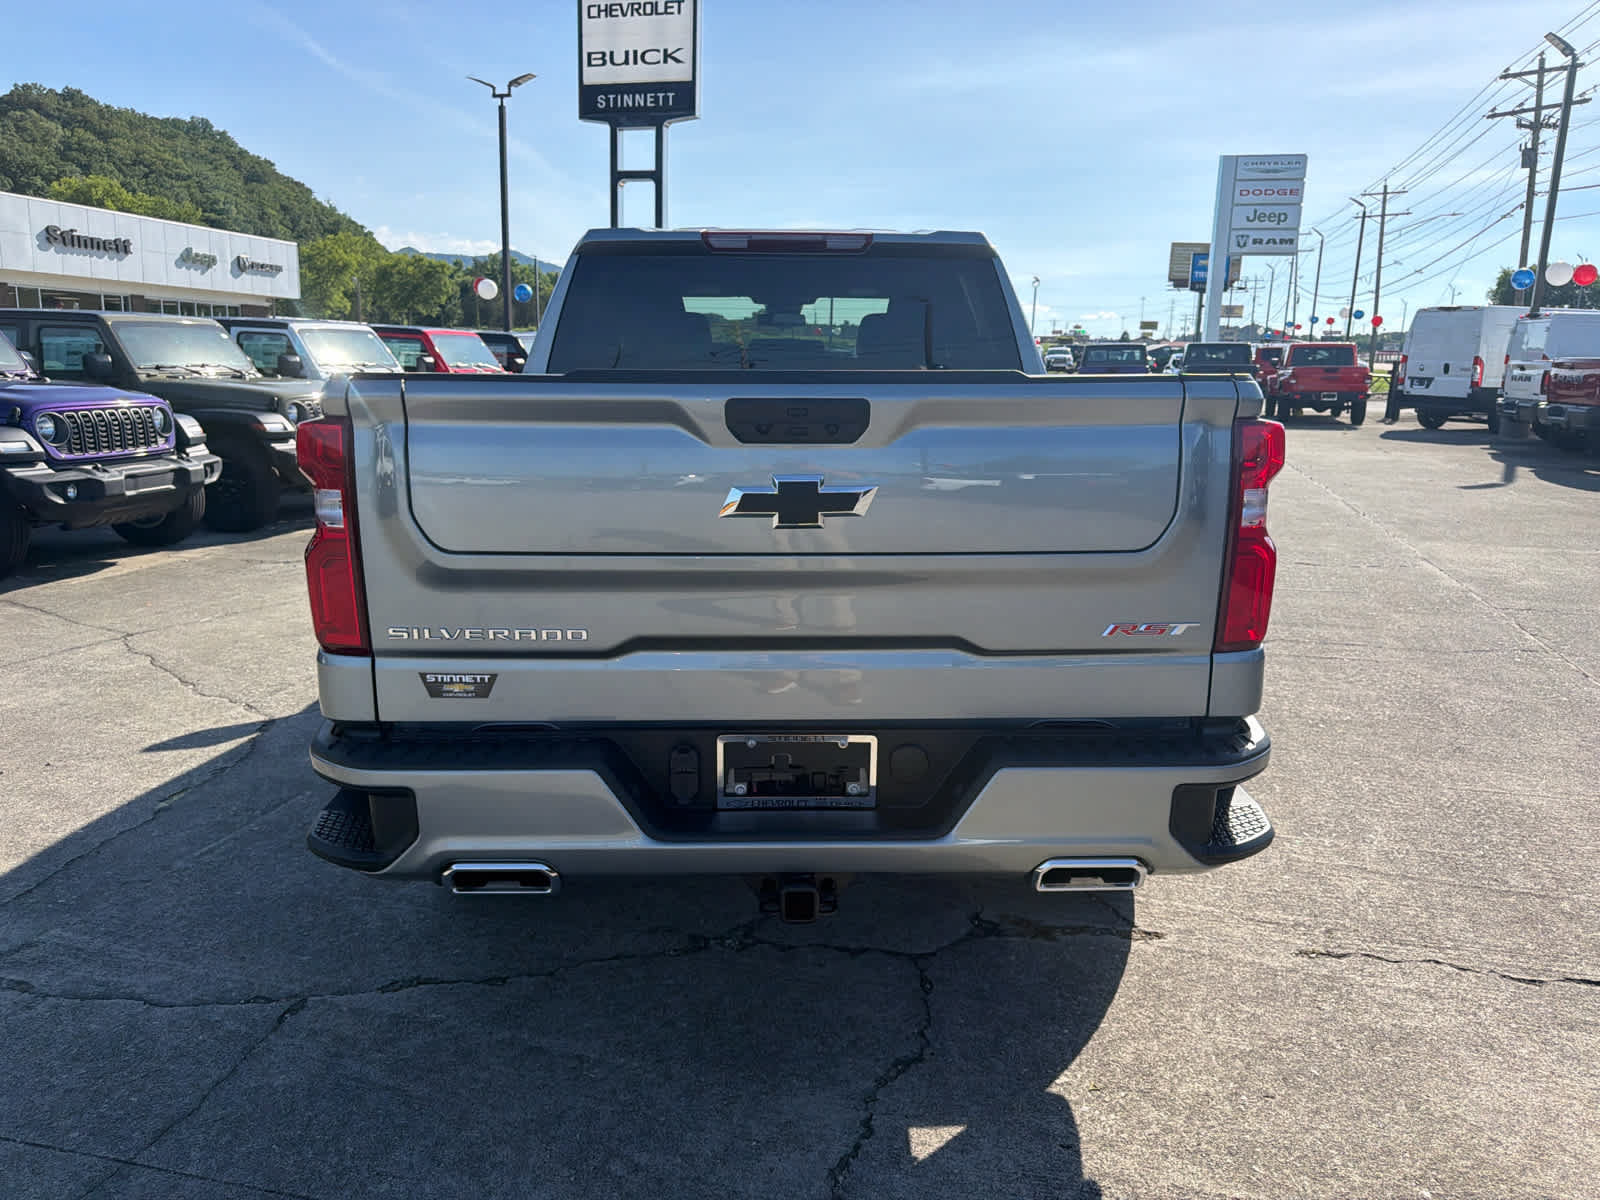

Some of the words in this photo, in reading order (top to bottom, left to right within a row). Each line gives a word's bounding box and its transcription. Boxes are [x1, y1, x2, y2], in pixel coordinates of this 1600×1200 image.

[587, 0, 685, 19] CHEVROLET
[586, 47, 685, 68] BUICK
[597, 92, 676, 109] STINNETT
[1239, 188, 1300, 197] DODGE
[1246, 208, 1289, 225] Jeep
[46, 224, 133, 255] Stinnett
[1252, 237, 1296, 246] RAM
[1511, 374, 1532, 383] RAM
[387, 626, 590, 641] SILVERADO
[1102, 622, 1201, 637] RST
[426, 673, 491, 683] STINNETT
